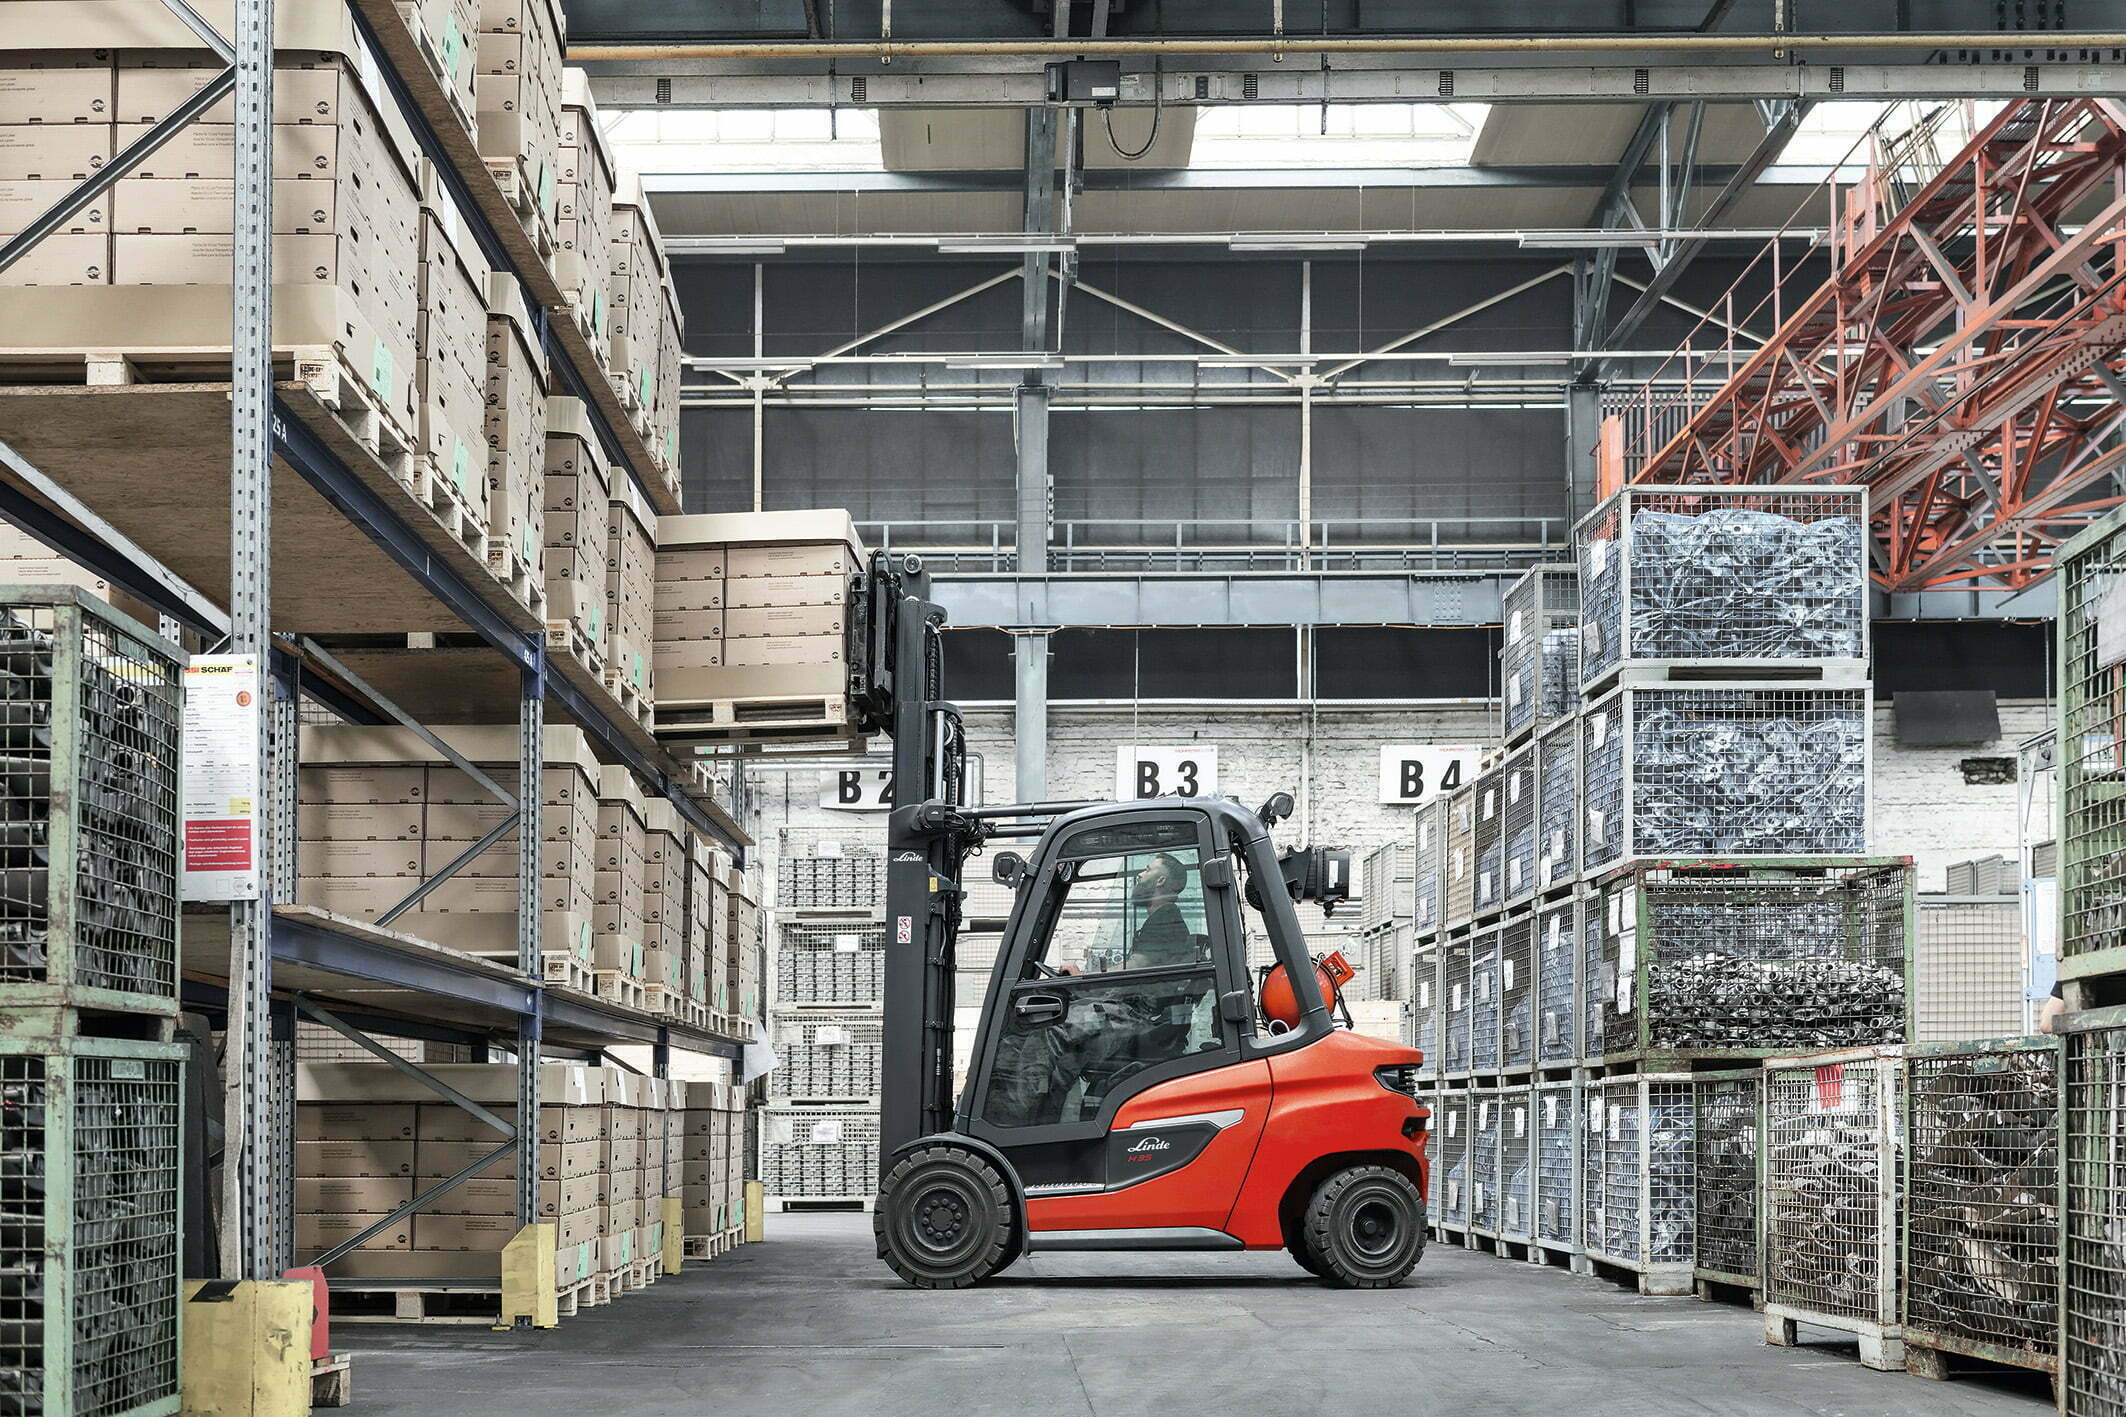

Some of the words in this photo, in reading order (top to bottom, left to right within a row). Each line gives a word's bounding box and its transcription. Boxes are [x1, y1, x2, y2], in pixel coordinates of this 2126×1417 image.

[839, 770, 862, 804] B
[878, 770, 894, 804] 2
[1137, 760, 1160, 799] B
[1177, 760, 1199, 798] 3
[1400, 760, 1424, 799] B
[1440, 760, 1462, 791] 4
[893, 851, 923, 862] Linde
[1127, 1136, 1170, 1152] Linde
